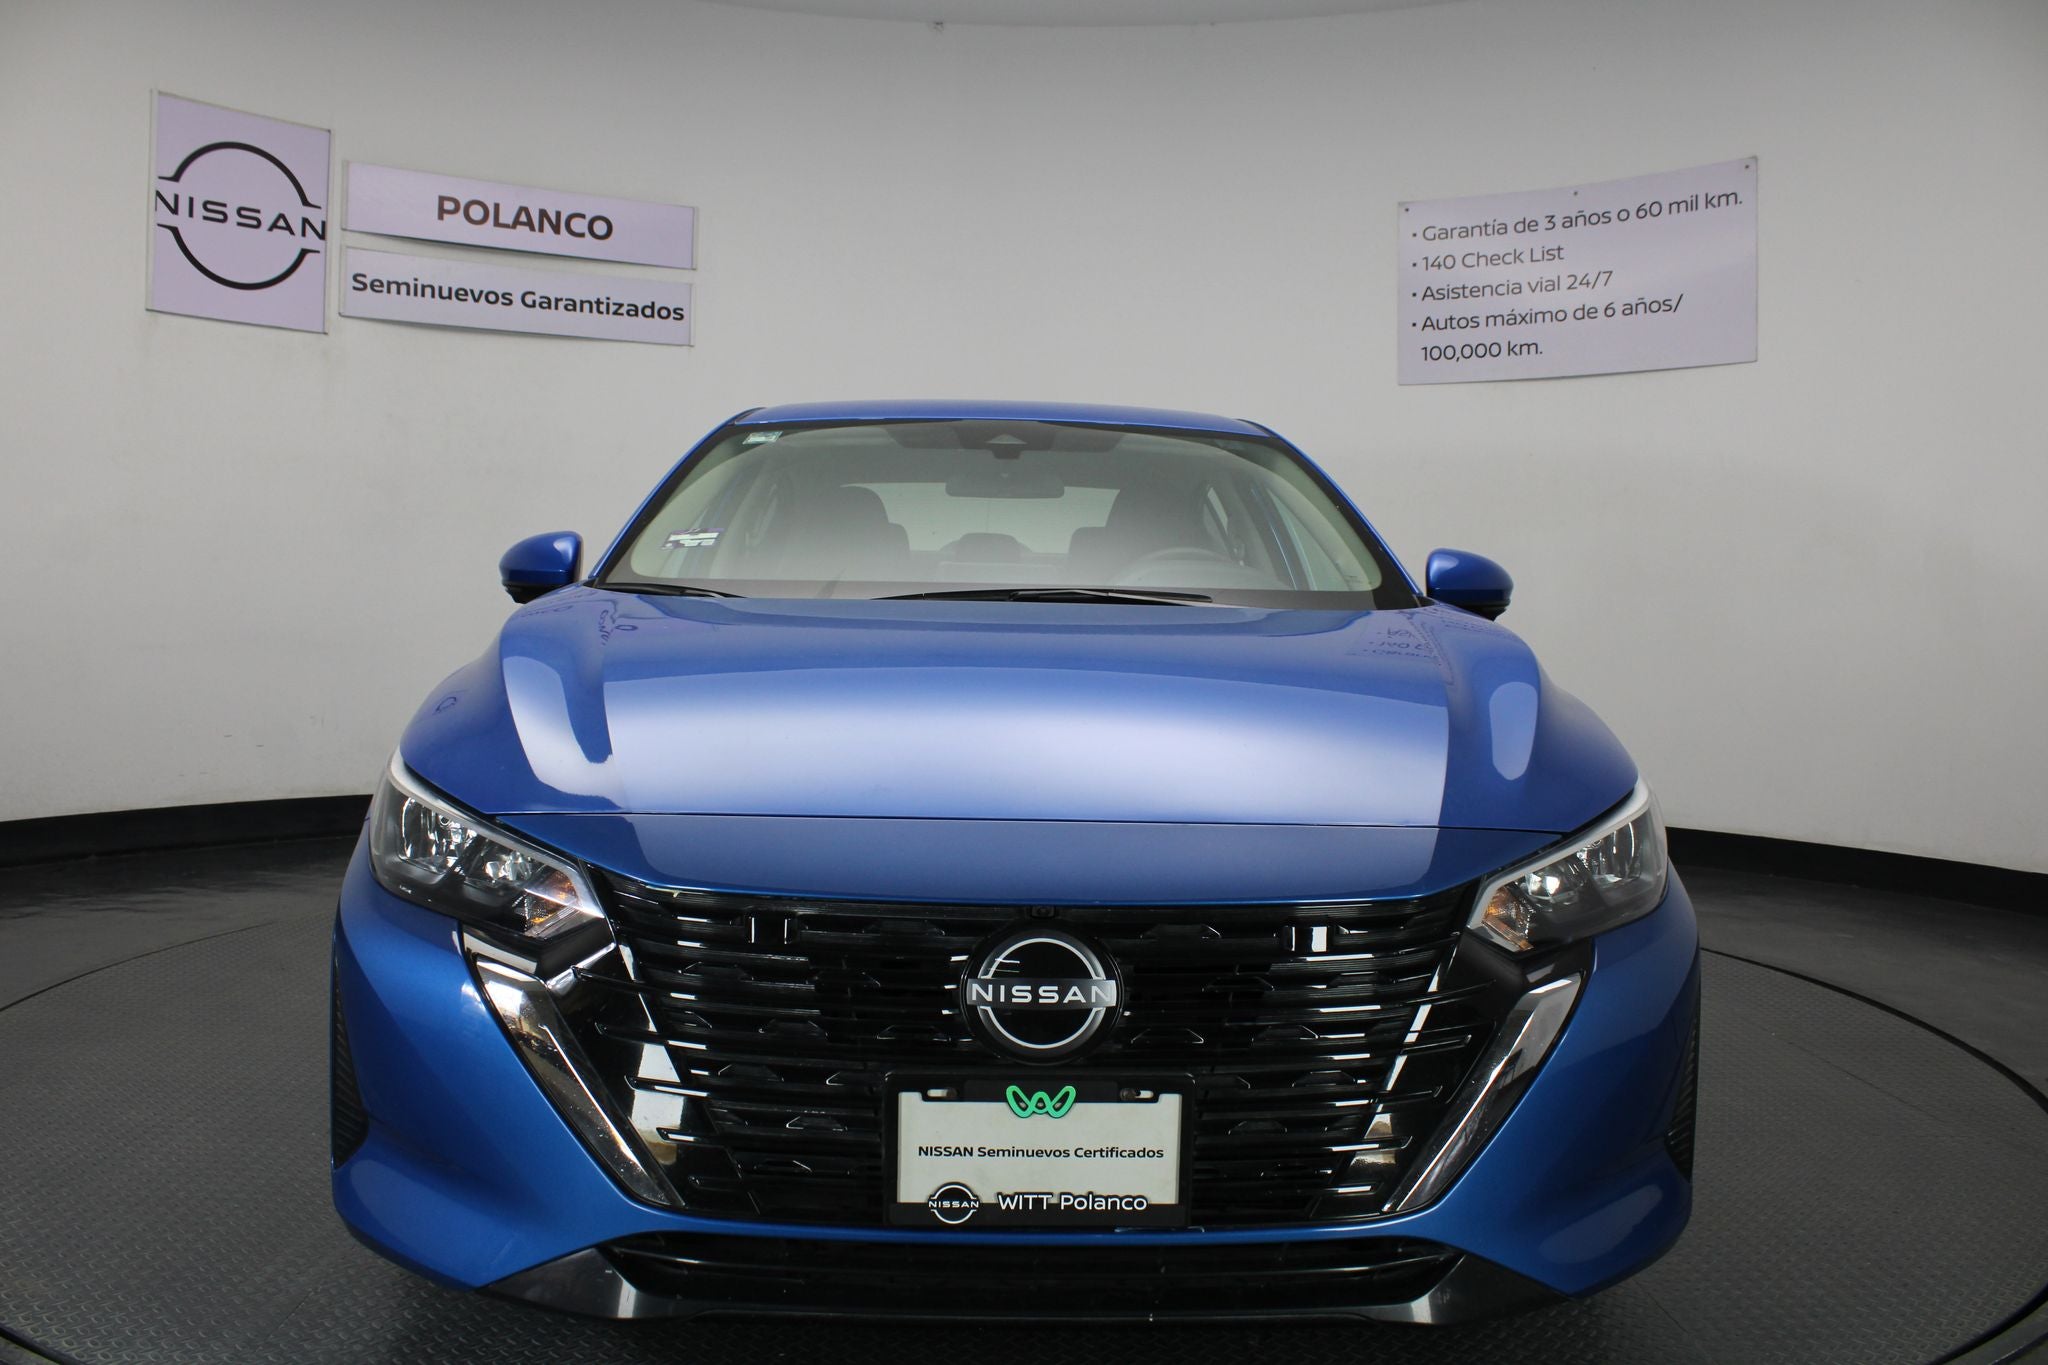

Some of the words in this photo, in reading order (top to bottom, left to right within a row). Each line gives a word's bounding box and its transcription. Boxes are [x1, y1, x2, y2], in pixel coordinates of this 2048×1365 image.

[155, 190, 326, 240] NISSAN
[437, 195, 614, 241] POLANCO
[1422, 218, 1508, 241] Garantía
[1514, 217, 1538, 234] de
[1545, 215, 1556, 231] 3
[1562, 211, 1612, 229] años
[1617, 209, 1629, 222] o
[1636, 201, 1662, 219] 60
[1668, 195, 1698, 215] mil
[1705, 191, 1743, 209] km.
[1422, 255, 1456, 271] 140
[1462, 249, 1524, 269] Check
[1530, 245, 1564, 262] List
[352, 273, 514, 306] Seminuevos
[521, 291, 685, 322] Garantizados
[1422, 280, 1522, 301] Asistencia
[1528, 276, 1561, 293] vial
[1567, 271, 1613, 290] 24/7
[1422, 313, 1480, 331] Autos
[1485, 307, 1567, 328] máximo
[1573, 304, 1598, 321] de
[1604, 302, 1616, 318] 6
[1622, 294, 1683, 315] años/
[1422, 342, 1501, 362] 100,000
[1507, 340, 1543, 357] km.
[971, 983, 1115, 1003] NISSAN
[918, 1146, 974, 1157] NISSAN
[978, 1146, 1070, 1158] Seminuevos
[1074, 1146, 1164, 1158] Certificados
[929, 1200, 979, 1208] NISSAN
[998, 1194, 1053, 1210] WITT
[1060, 1194, 1147, 1210] Polanco
